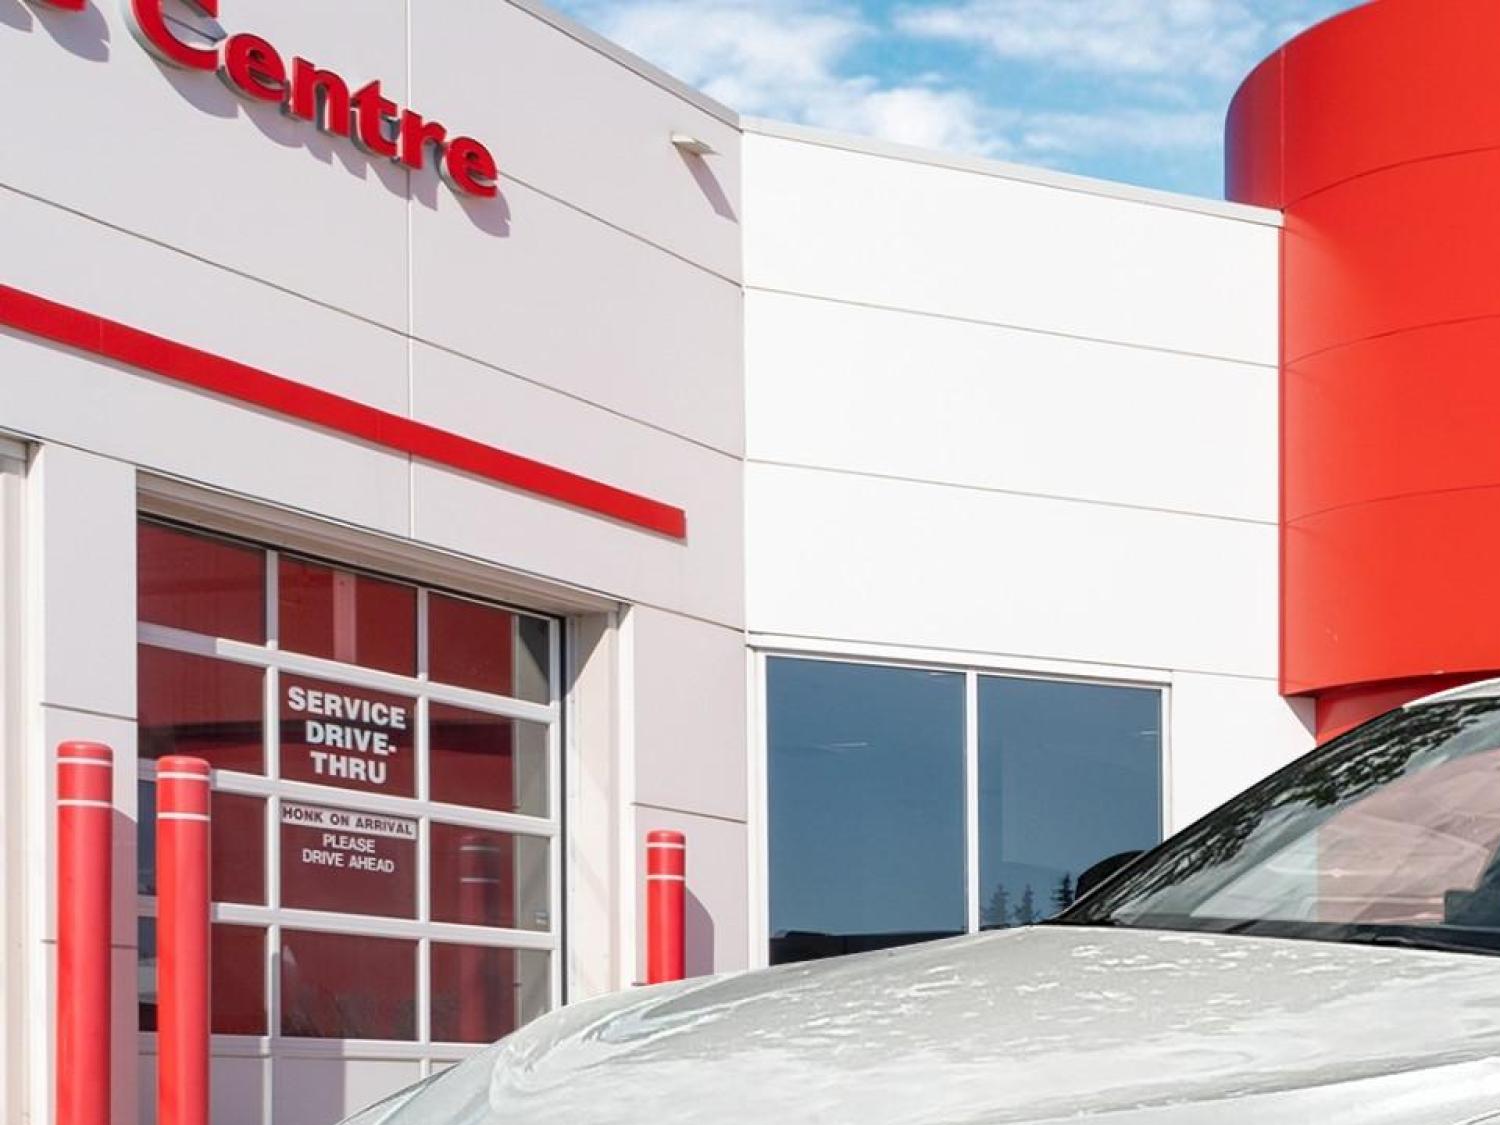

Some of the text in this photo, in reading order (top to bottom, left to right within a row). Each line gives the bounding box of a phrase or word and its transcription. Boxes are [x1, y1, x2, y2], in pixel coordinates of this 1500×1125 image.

[130, 0, 498, 198] Centre
[288, 686, 406, 729] SERVICE
[306, 720, 397, 755] DRIVE-
[310, 751, 386, 784] THRU
[282, 807, 413, 835] HONK ON ARRIVAL
[322, 833, 375, 853] PLEASE
[302, 848, 395, 873] DRIVE AHEAD
